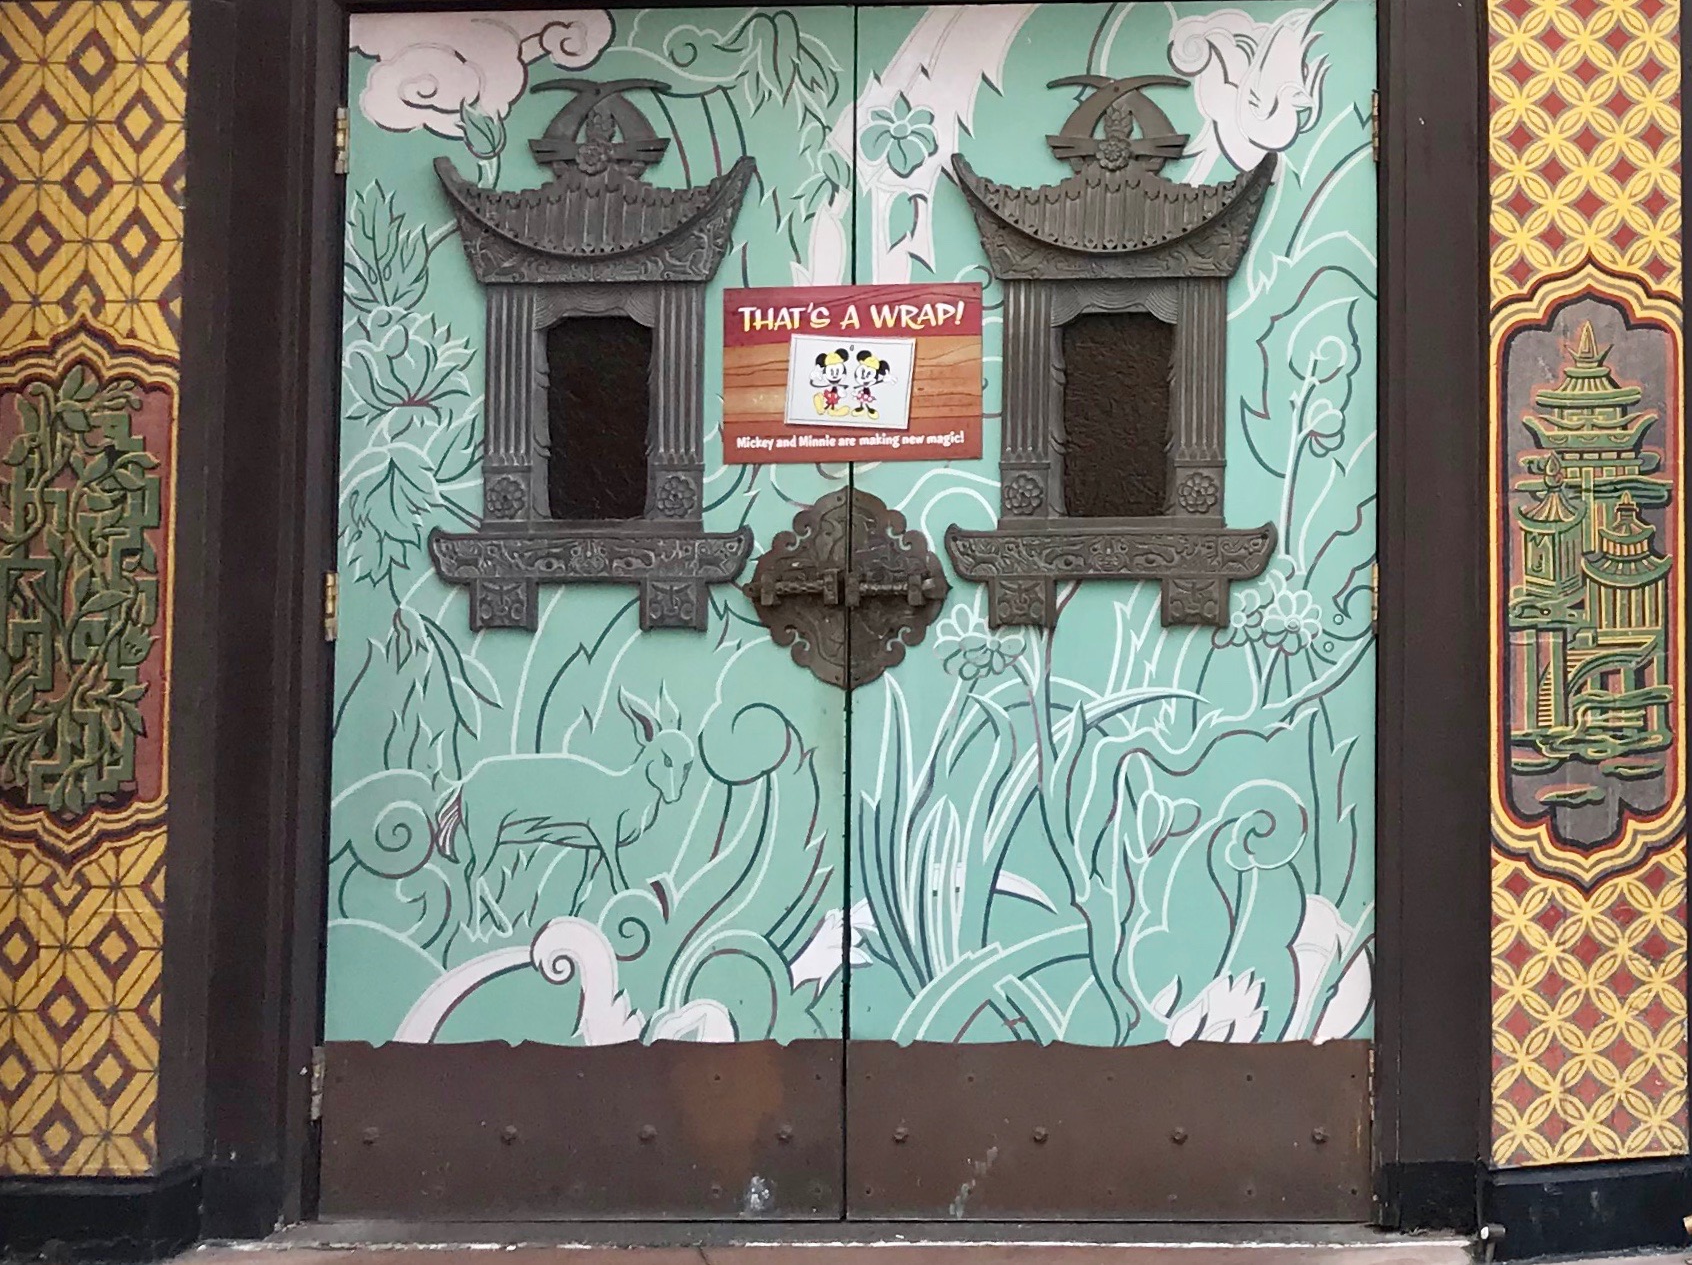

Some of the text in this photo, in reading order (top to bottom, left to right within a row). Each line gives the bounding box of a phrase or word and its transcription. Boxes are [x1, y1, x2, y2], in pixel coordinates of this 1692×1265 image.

[738, 301, 965, 332] THAT'S A WRAP!
[736, 430, 965, 451] Mickey and Minnie are making new magic!
